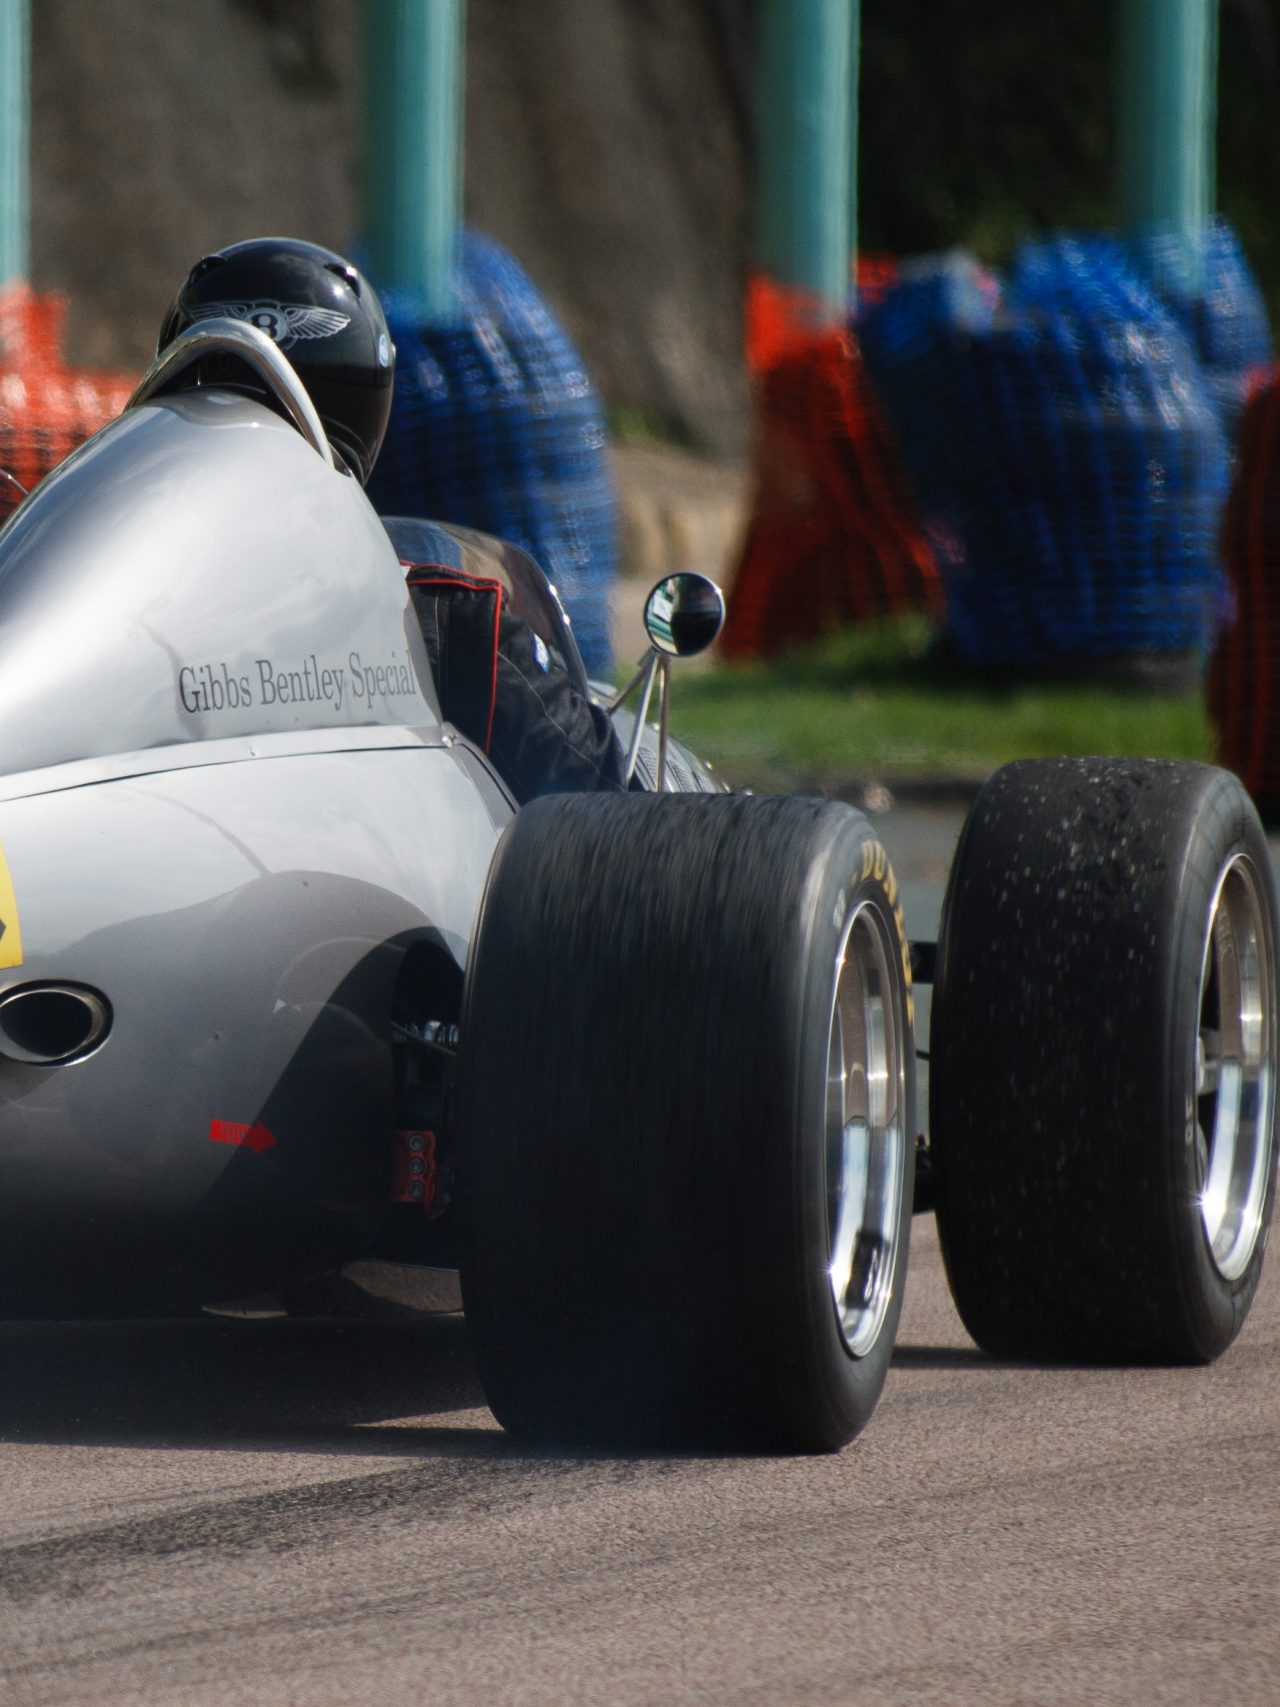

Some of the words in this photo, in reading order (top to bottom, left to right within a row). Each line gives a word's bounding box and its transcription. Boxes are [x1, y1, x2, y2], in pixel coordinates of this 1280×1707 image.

[179, 663, 252, 714] Gibbs
[255, 654, 344, 711] Bentley
[348, 649, 417, 709] Special
